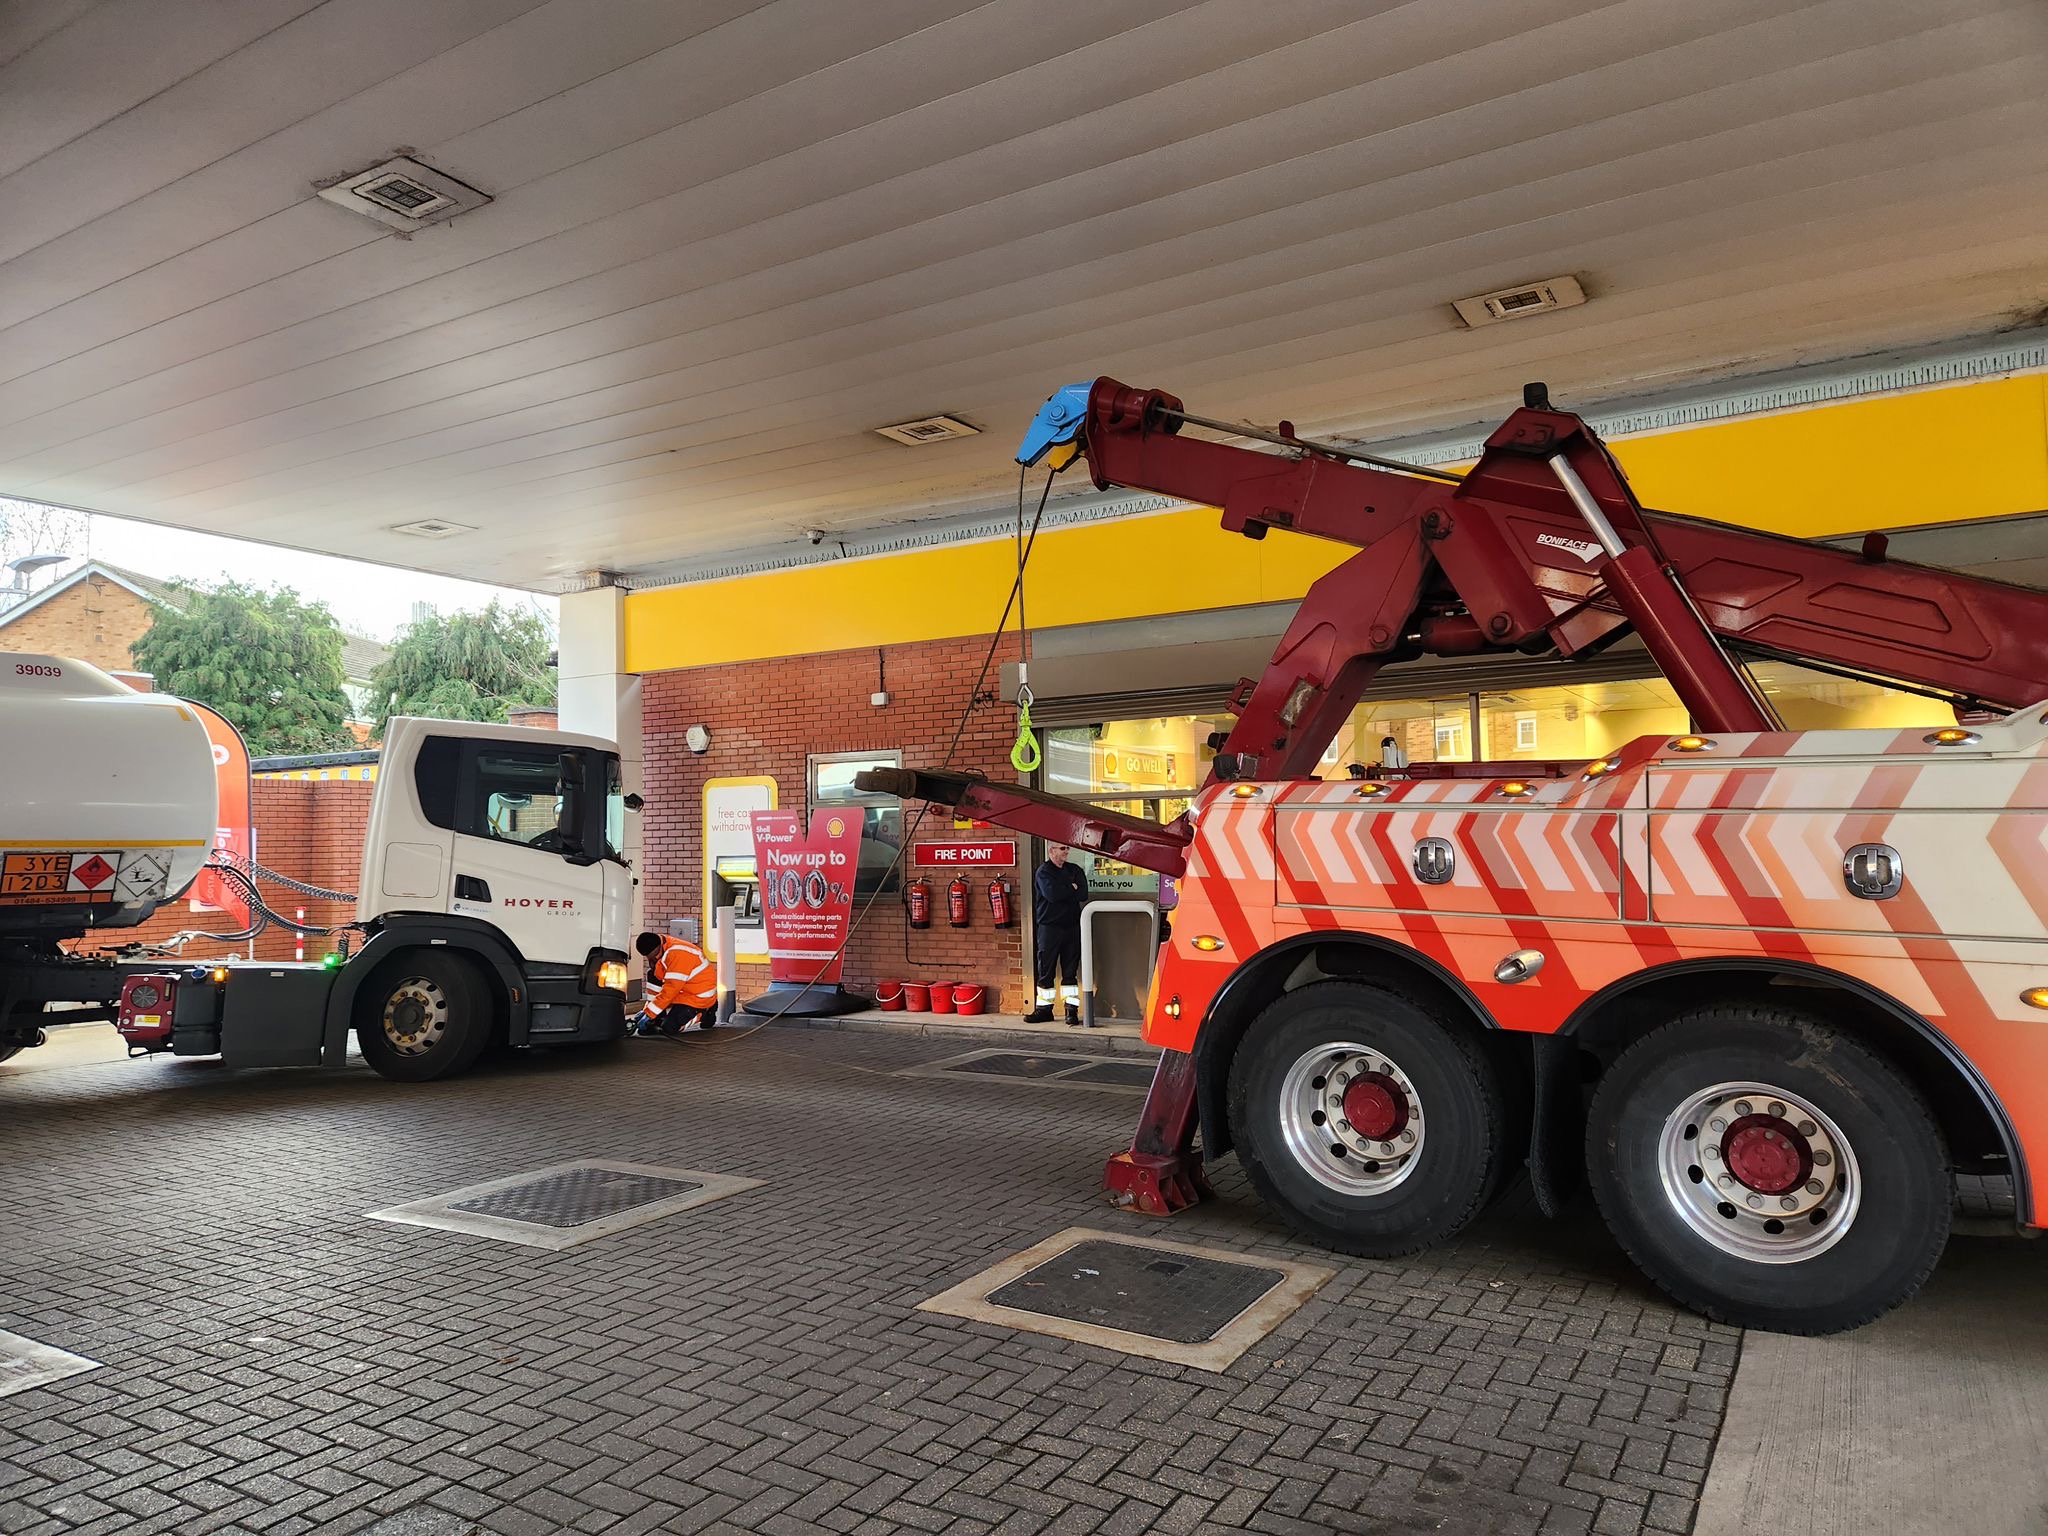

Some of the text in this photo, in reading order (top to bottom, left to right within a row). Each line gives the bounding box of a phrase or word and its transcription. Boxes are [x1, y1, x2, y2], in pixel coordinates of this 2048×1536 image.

[1537, 533, 1588, 551] BONIFACE
[15, 664, 62, 677] 39039
[1126, 757, 1162, 774] GO WELL
[718, 806, 753, 819] free cas
[711, 820, 752, 832] withdraw
[756, 825, 771, 833] Shell
[756, 834, 794, 843] V-Power
[767, 849, 846, 868] Now up to
[935, 848, 993, 860] FIRE POINT
[24, 857, 71, 871] 3YE
[7, 874, 65, 892] 1203
[765, 869, 850, 909] 100%
[1088, 880, 1133, 889] Thank you
[505, 898, 574, 909] HOYER
[771, 912, 787, 920] cleans
[805, 913, 825, 922] engine
[826, 914, 842, 922] parts
[781, 921, 792, 930] fully
[792, 922, 823, 930] rejuvenate
